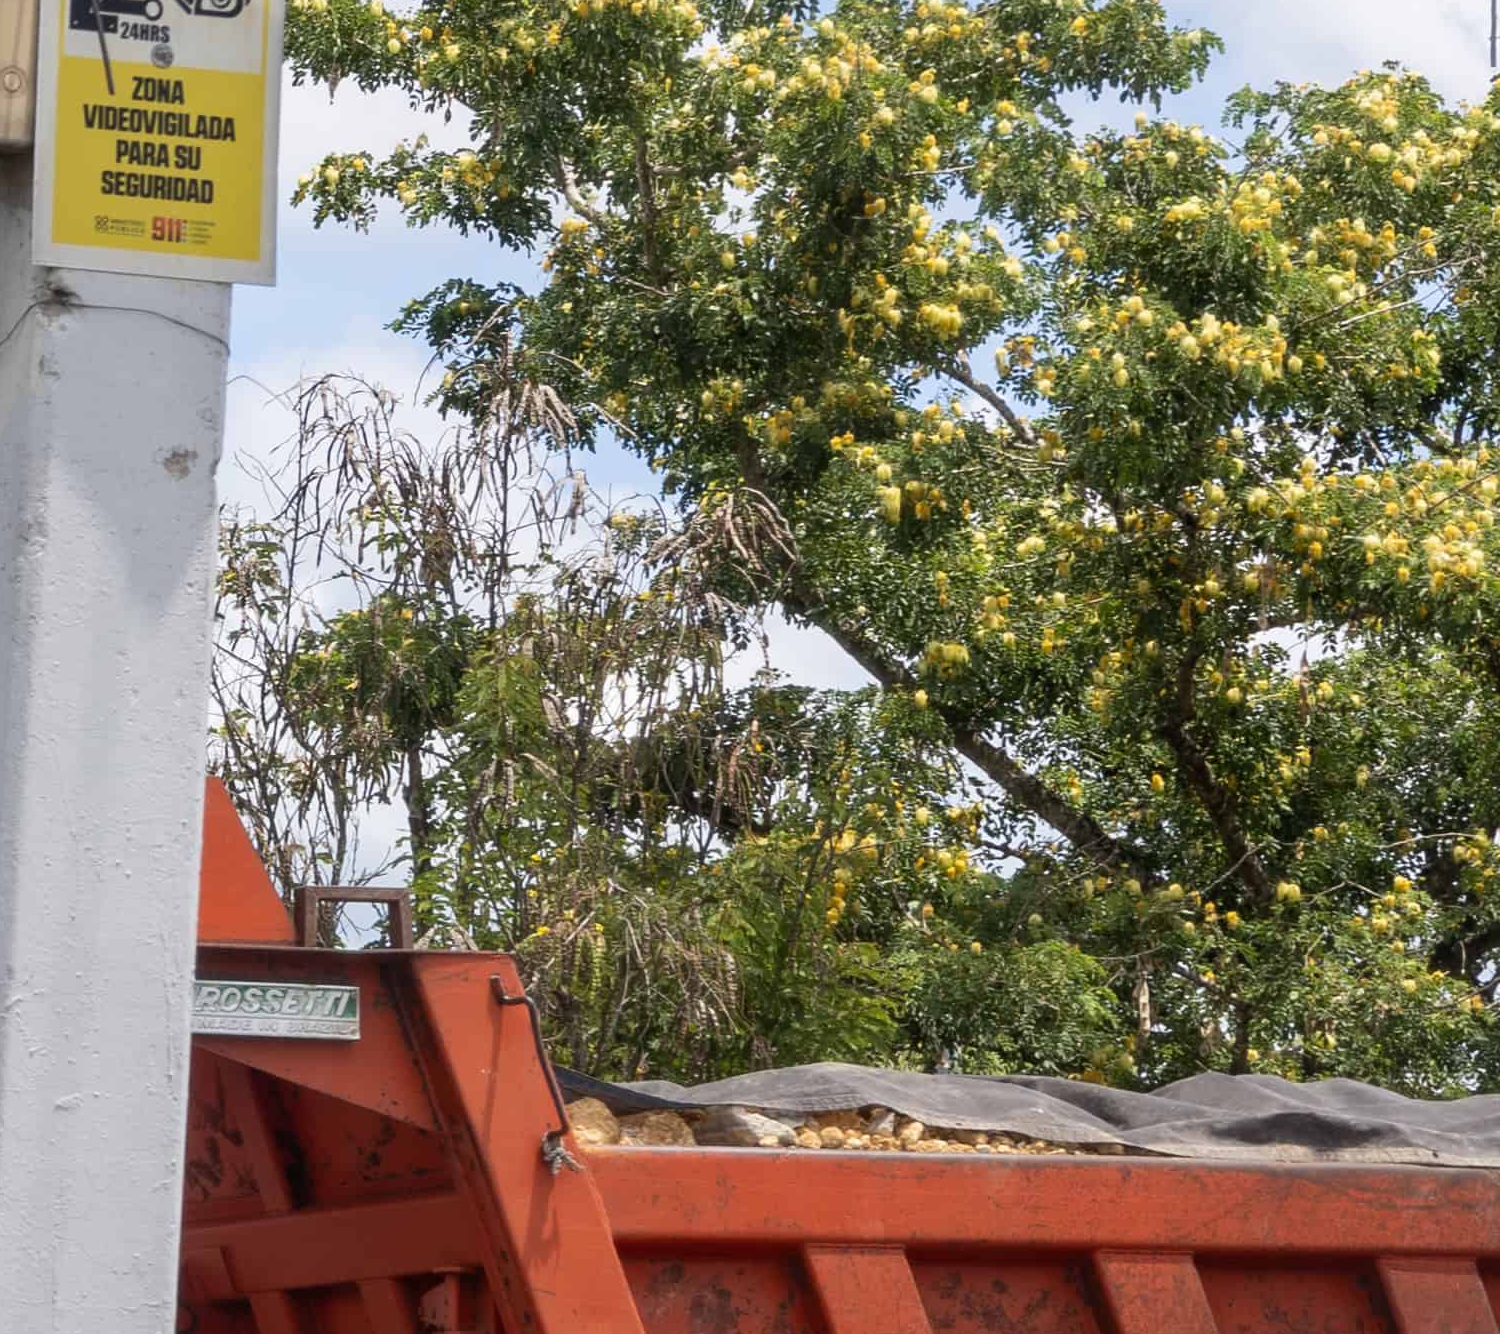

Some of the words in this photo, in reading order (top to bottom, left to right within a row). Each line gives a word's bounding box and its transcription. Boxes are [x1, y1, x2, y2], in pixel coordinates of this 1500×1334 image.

[120, 21, 170, 43] 24HRS
[131, 76, 185, 105] ZONA
[83, 104, 236, 142] VIDEOVIGILADA
[115, 139, 169, 168] PARA
[174, 145, 201, 171] SU
[101, 170, 214, 204] SEGURIDAD
[152, 217, 181, 243] 911
[194, 986, 350, 1017] ROSSETTI
